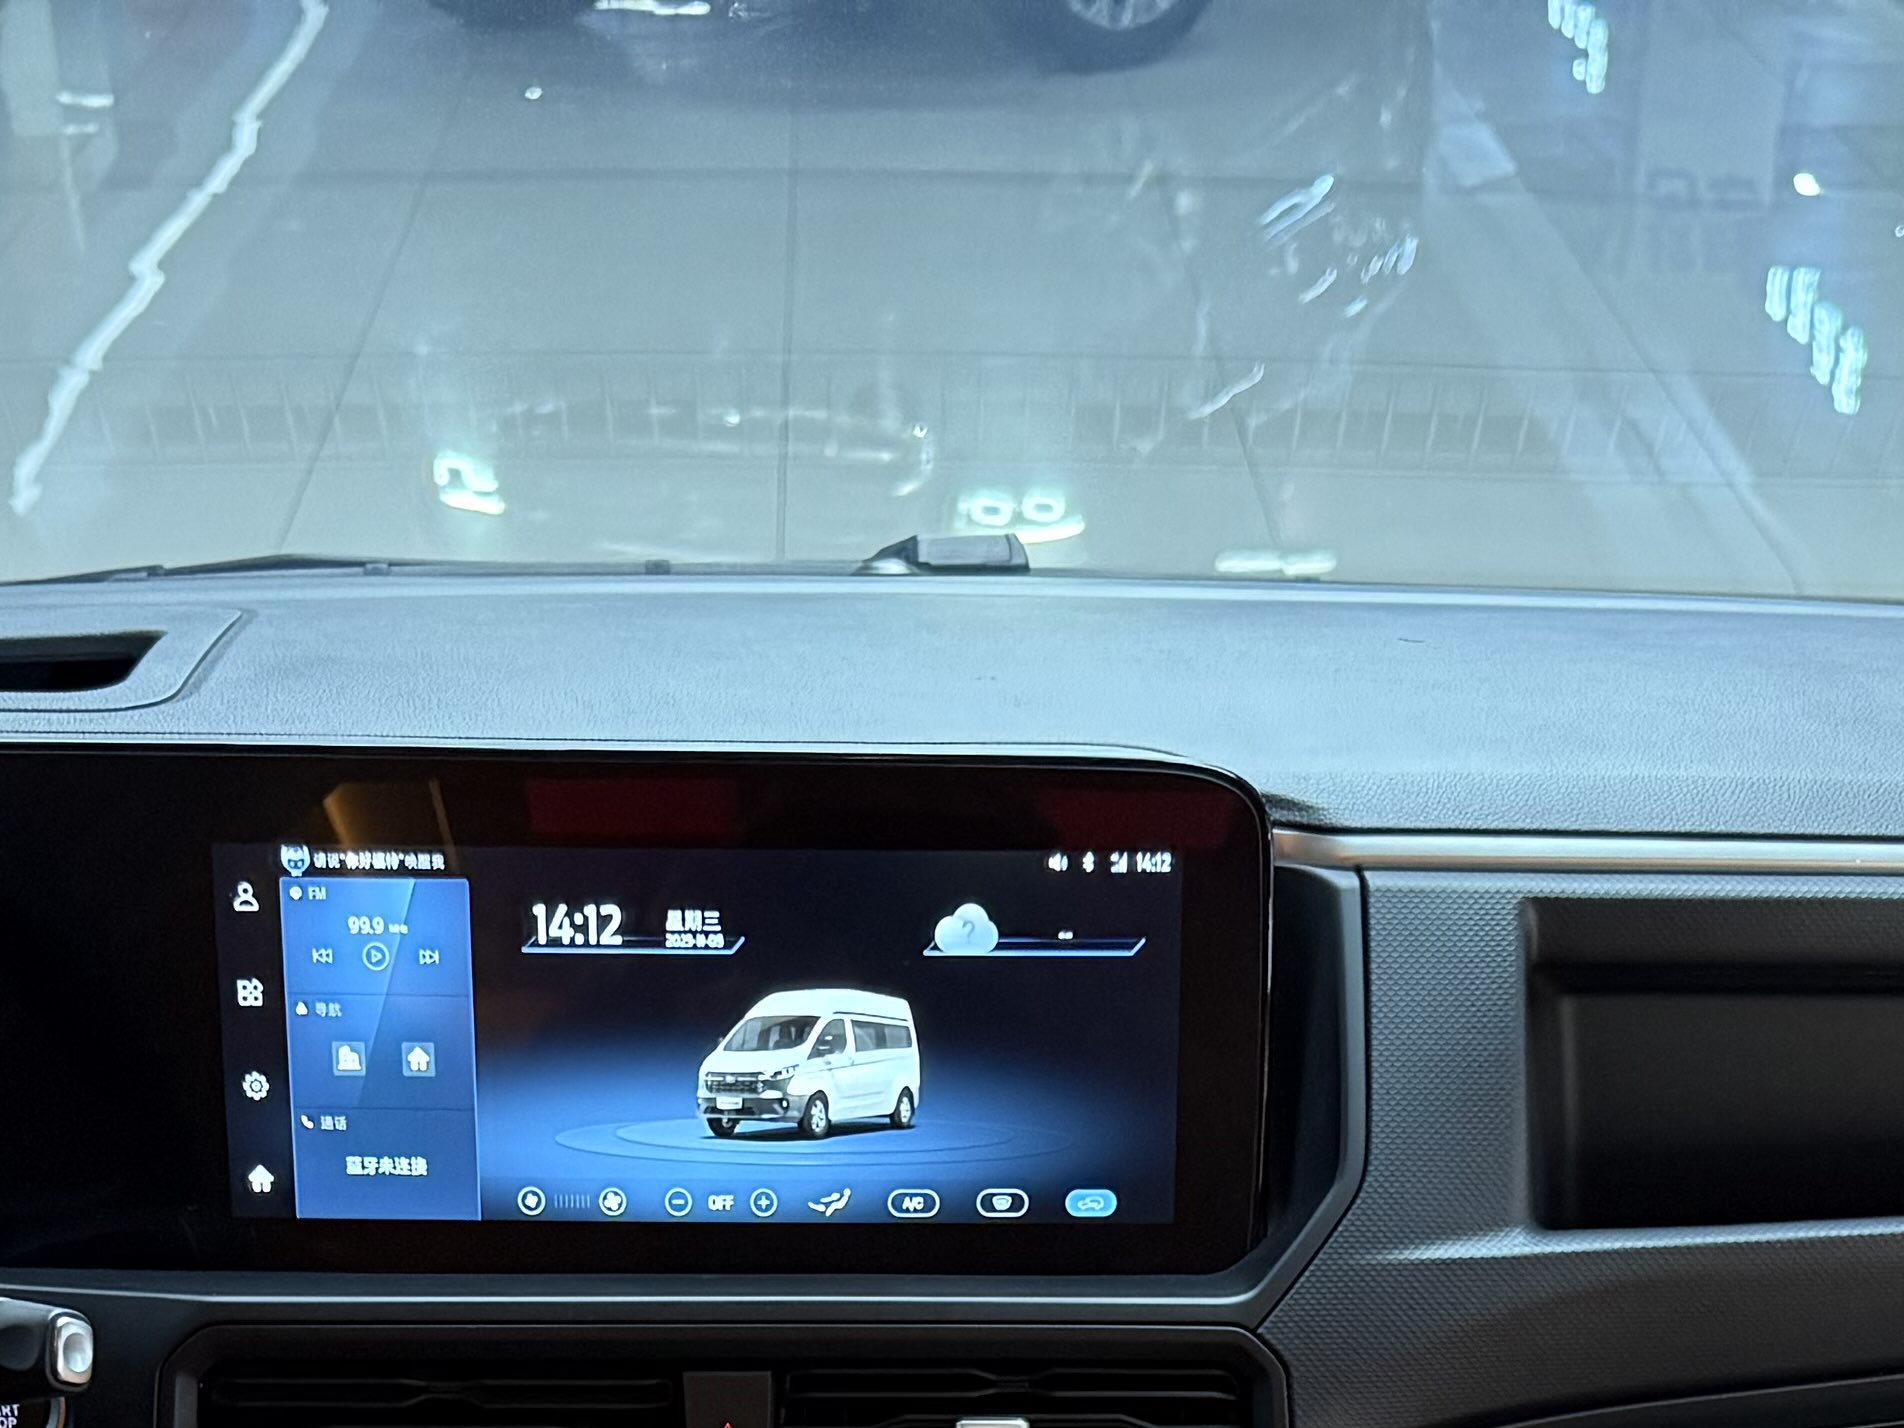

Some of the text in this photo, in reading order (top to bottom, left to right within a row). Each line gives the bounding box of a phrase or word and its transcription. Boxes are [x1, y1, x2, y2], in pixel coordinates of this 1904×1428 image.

[308, 886, 327, 901] FM
[347, 915, 385, 935] 99.9
[531, 903, 623, 945] 14:12
[665, 909, 722, 932] 星期三
[315, 1002, 343, 1017] 导航
[320, 1115, 347, 1131] 通话
[345, 1155, 428, 1176] 蓝牙未连接
[707, 1194, 735, 1211] OFF
